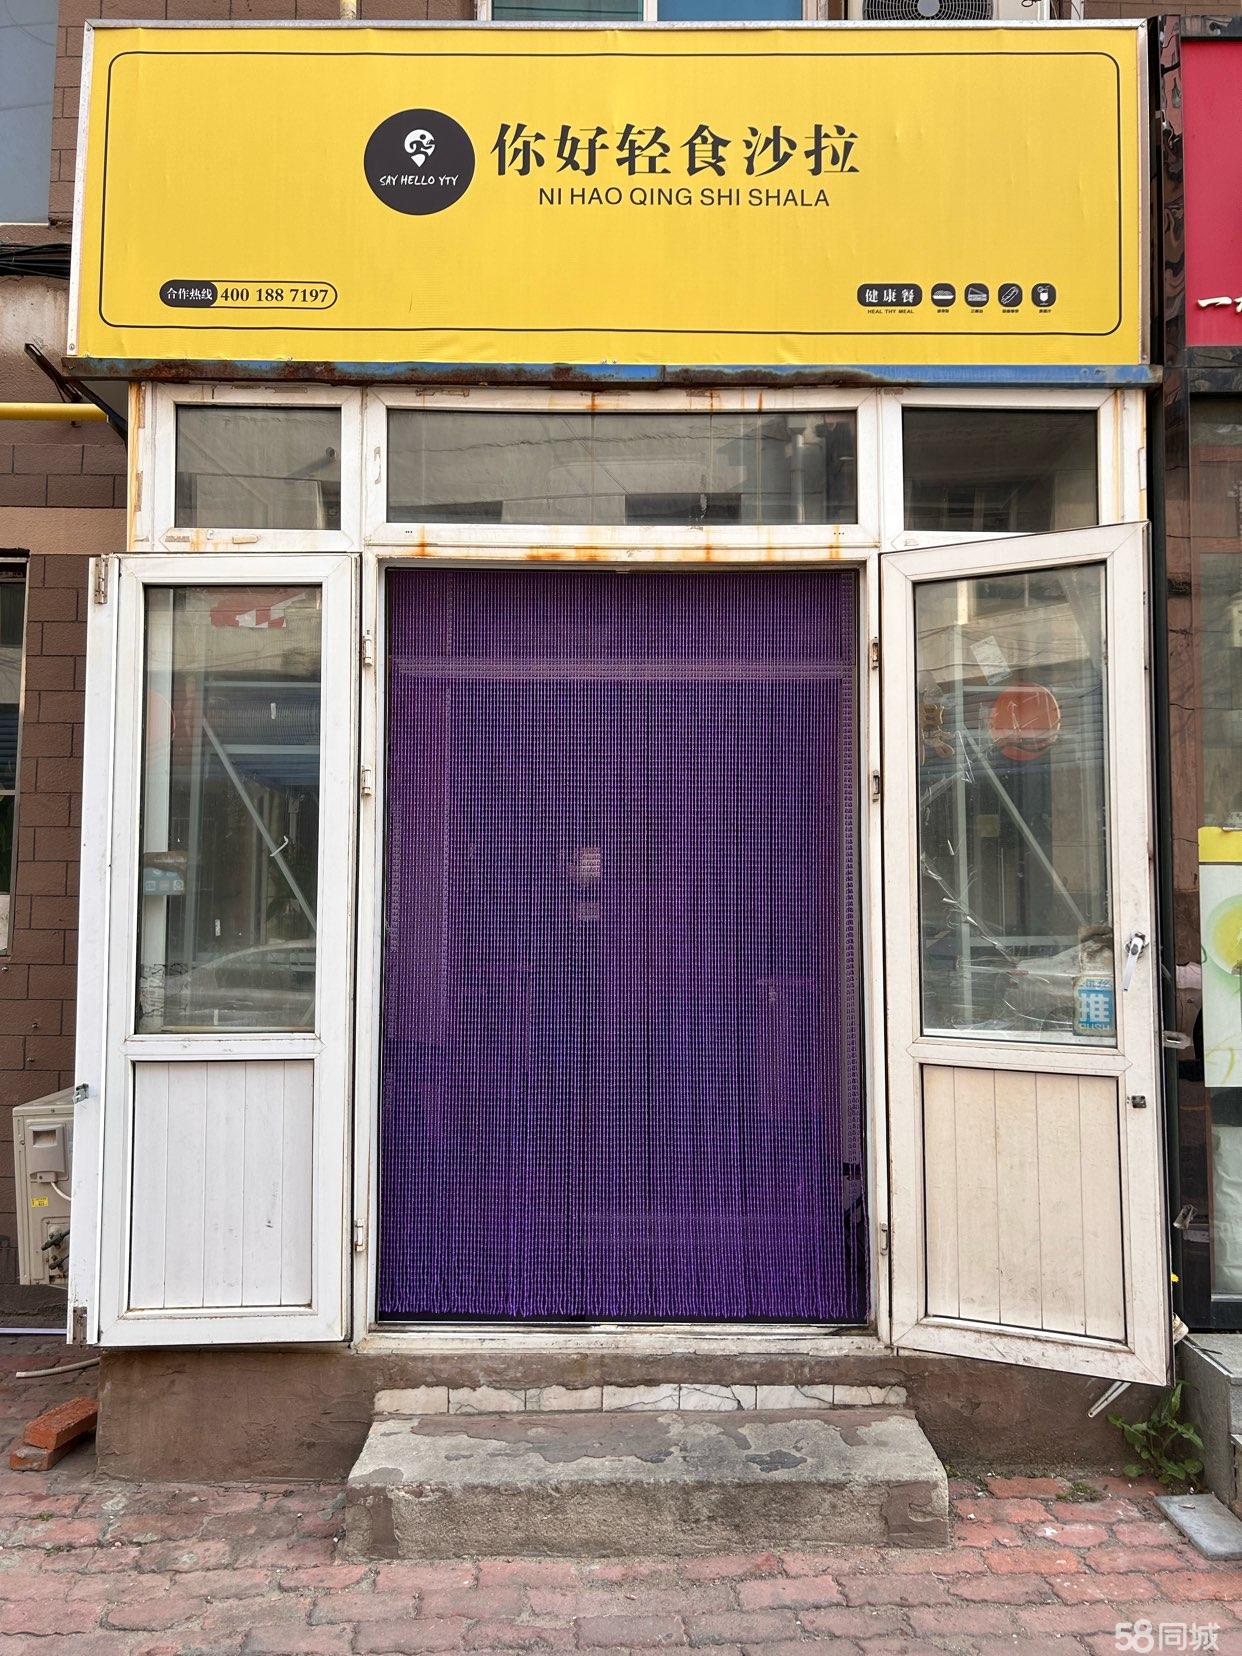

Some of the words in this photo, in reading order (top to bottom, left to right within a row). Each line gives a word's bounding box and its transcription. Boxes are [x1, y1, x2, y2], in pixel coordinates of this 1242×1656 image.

[490, 122, 860, 177] 你好轻食沙拉
[379, 174, 399, 186] SAY
[400, 174, 436, 186] HELLO
[438, 174, 459, 187] YTY
[539, 187, 562, 205] NI
[570, 187, 623, 205] HAO
[629, 187, 692, 206] QING
[700, 188, 740, 206] SHI
[748, 188, 830, 207] SHALA
[166, 287, 213, 301] 合作热线
[220, 287, 250, 302] 400
[256, 288, 284, 302] 188
[290, 288, 329, 303] 7197
[865, 288, 915, 303] 健康餐
[1078, 992, 1110, 1022] 推
